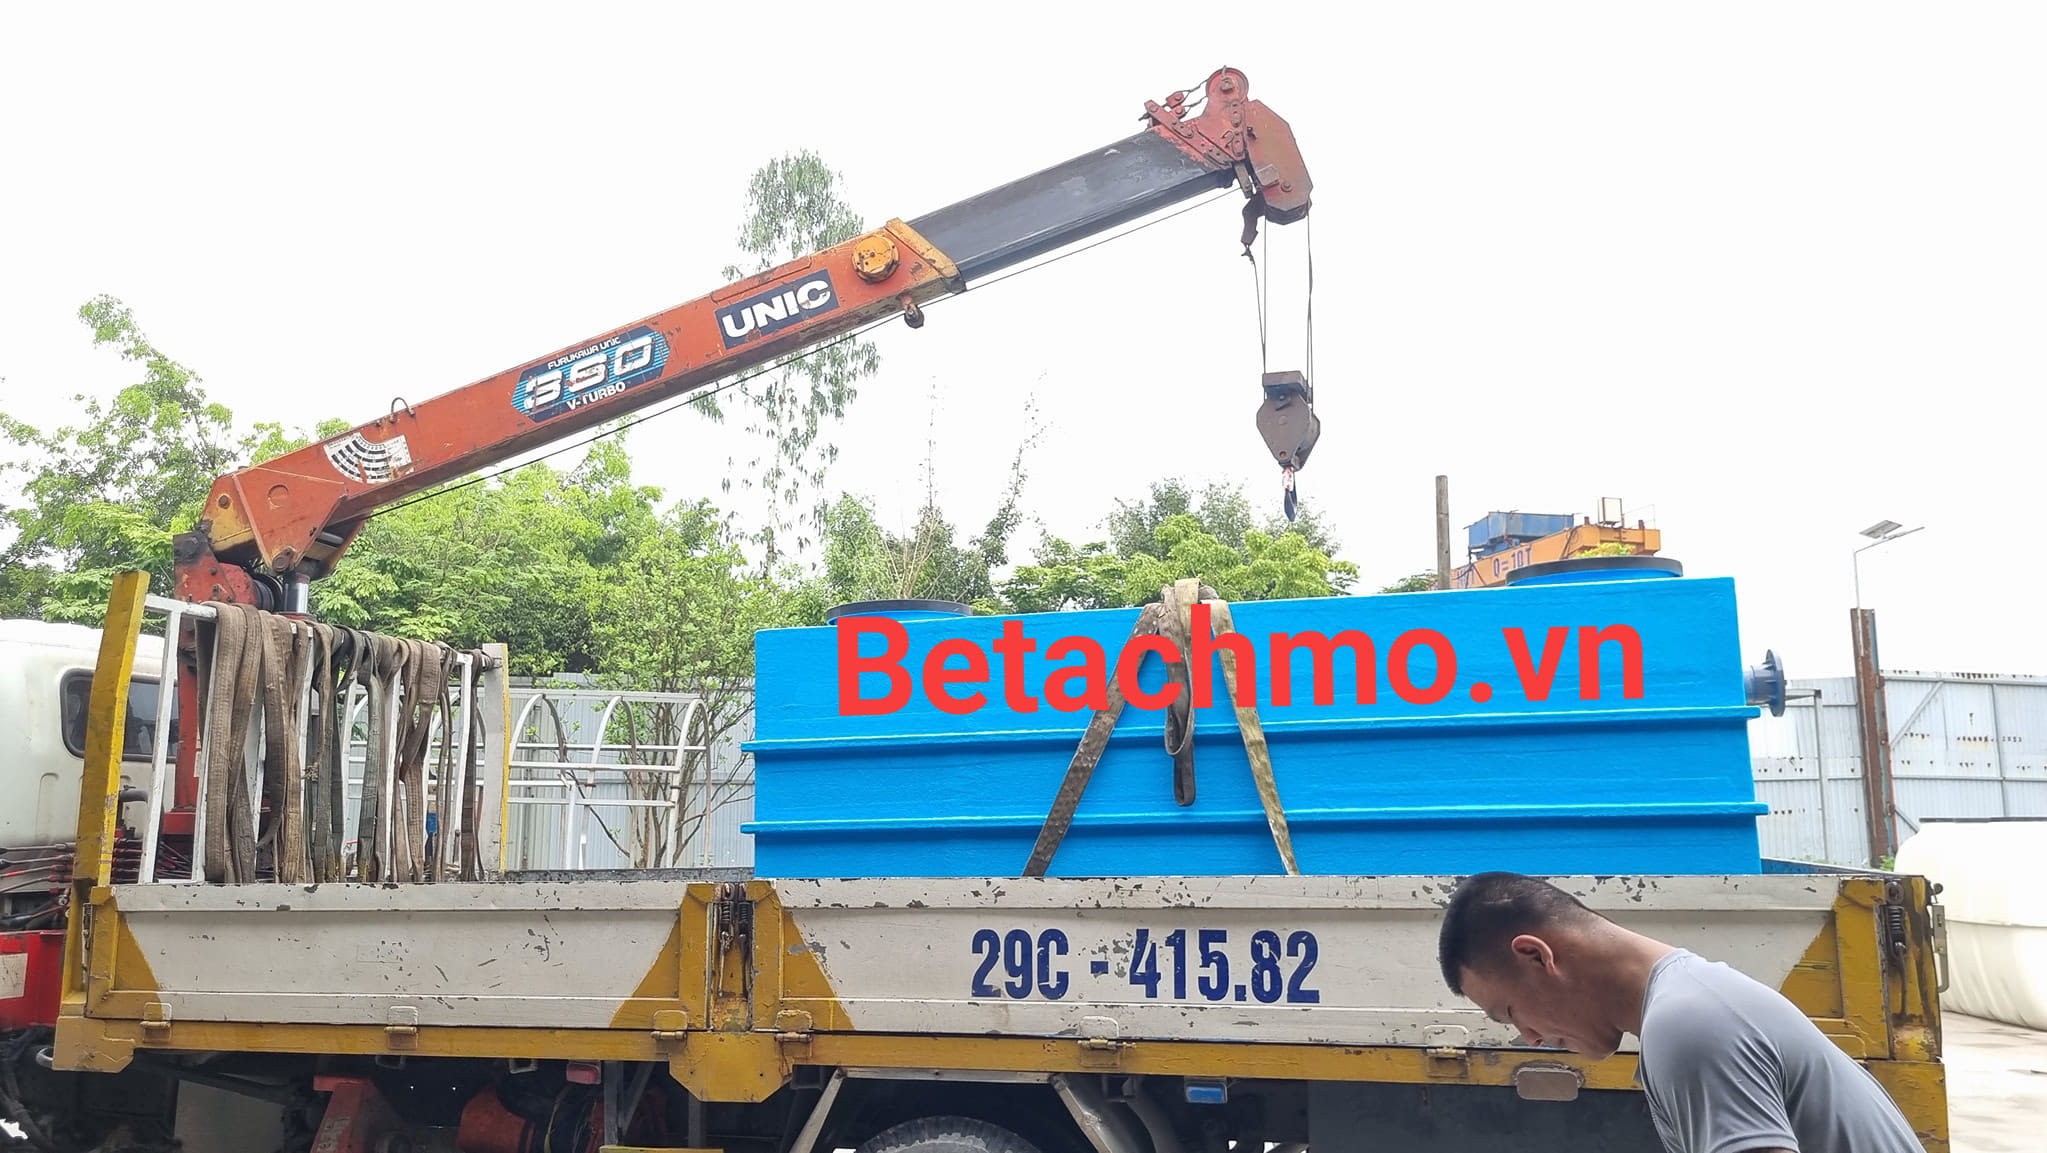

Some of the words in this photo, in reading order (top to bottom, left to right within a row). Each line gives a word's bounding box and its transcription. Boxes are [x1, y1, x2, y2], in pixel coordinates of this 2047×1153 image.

[722, 280, 831, 338] UNIC
[547, 344, 599, 370] FURUKAWA
[600, 336, 622, 350] UNIC
[566, 381, 626, 410] V-TURBO
[971, 928, 1069, 1000] 29C
[1129, 928, 1320, 1004] 415.82
